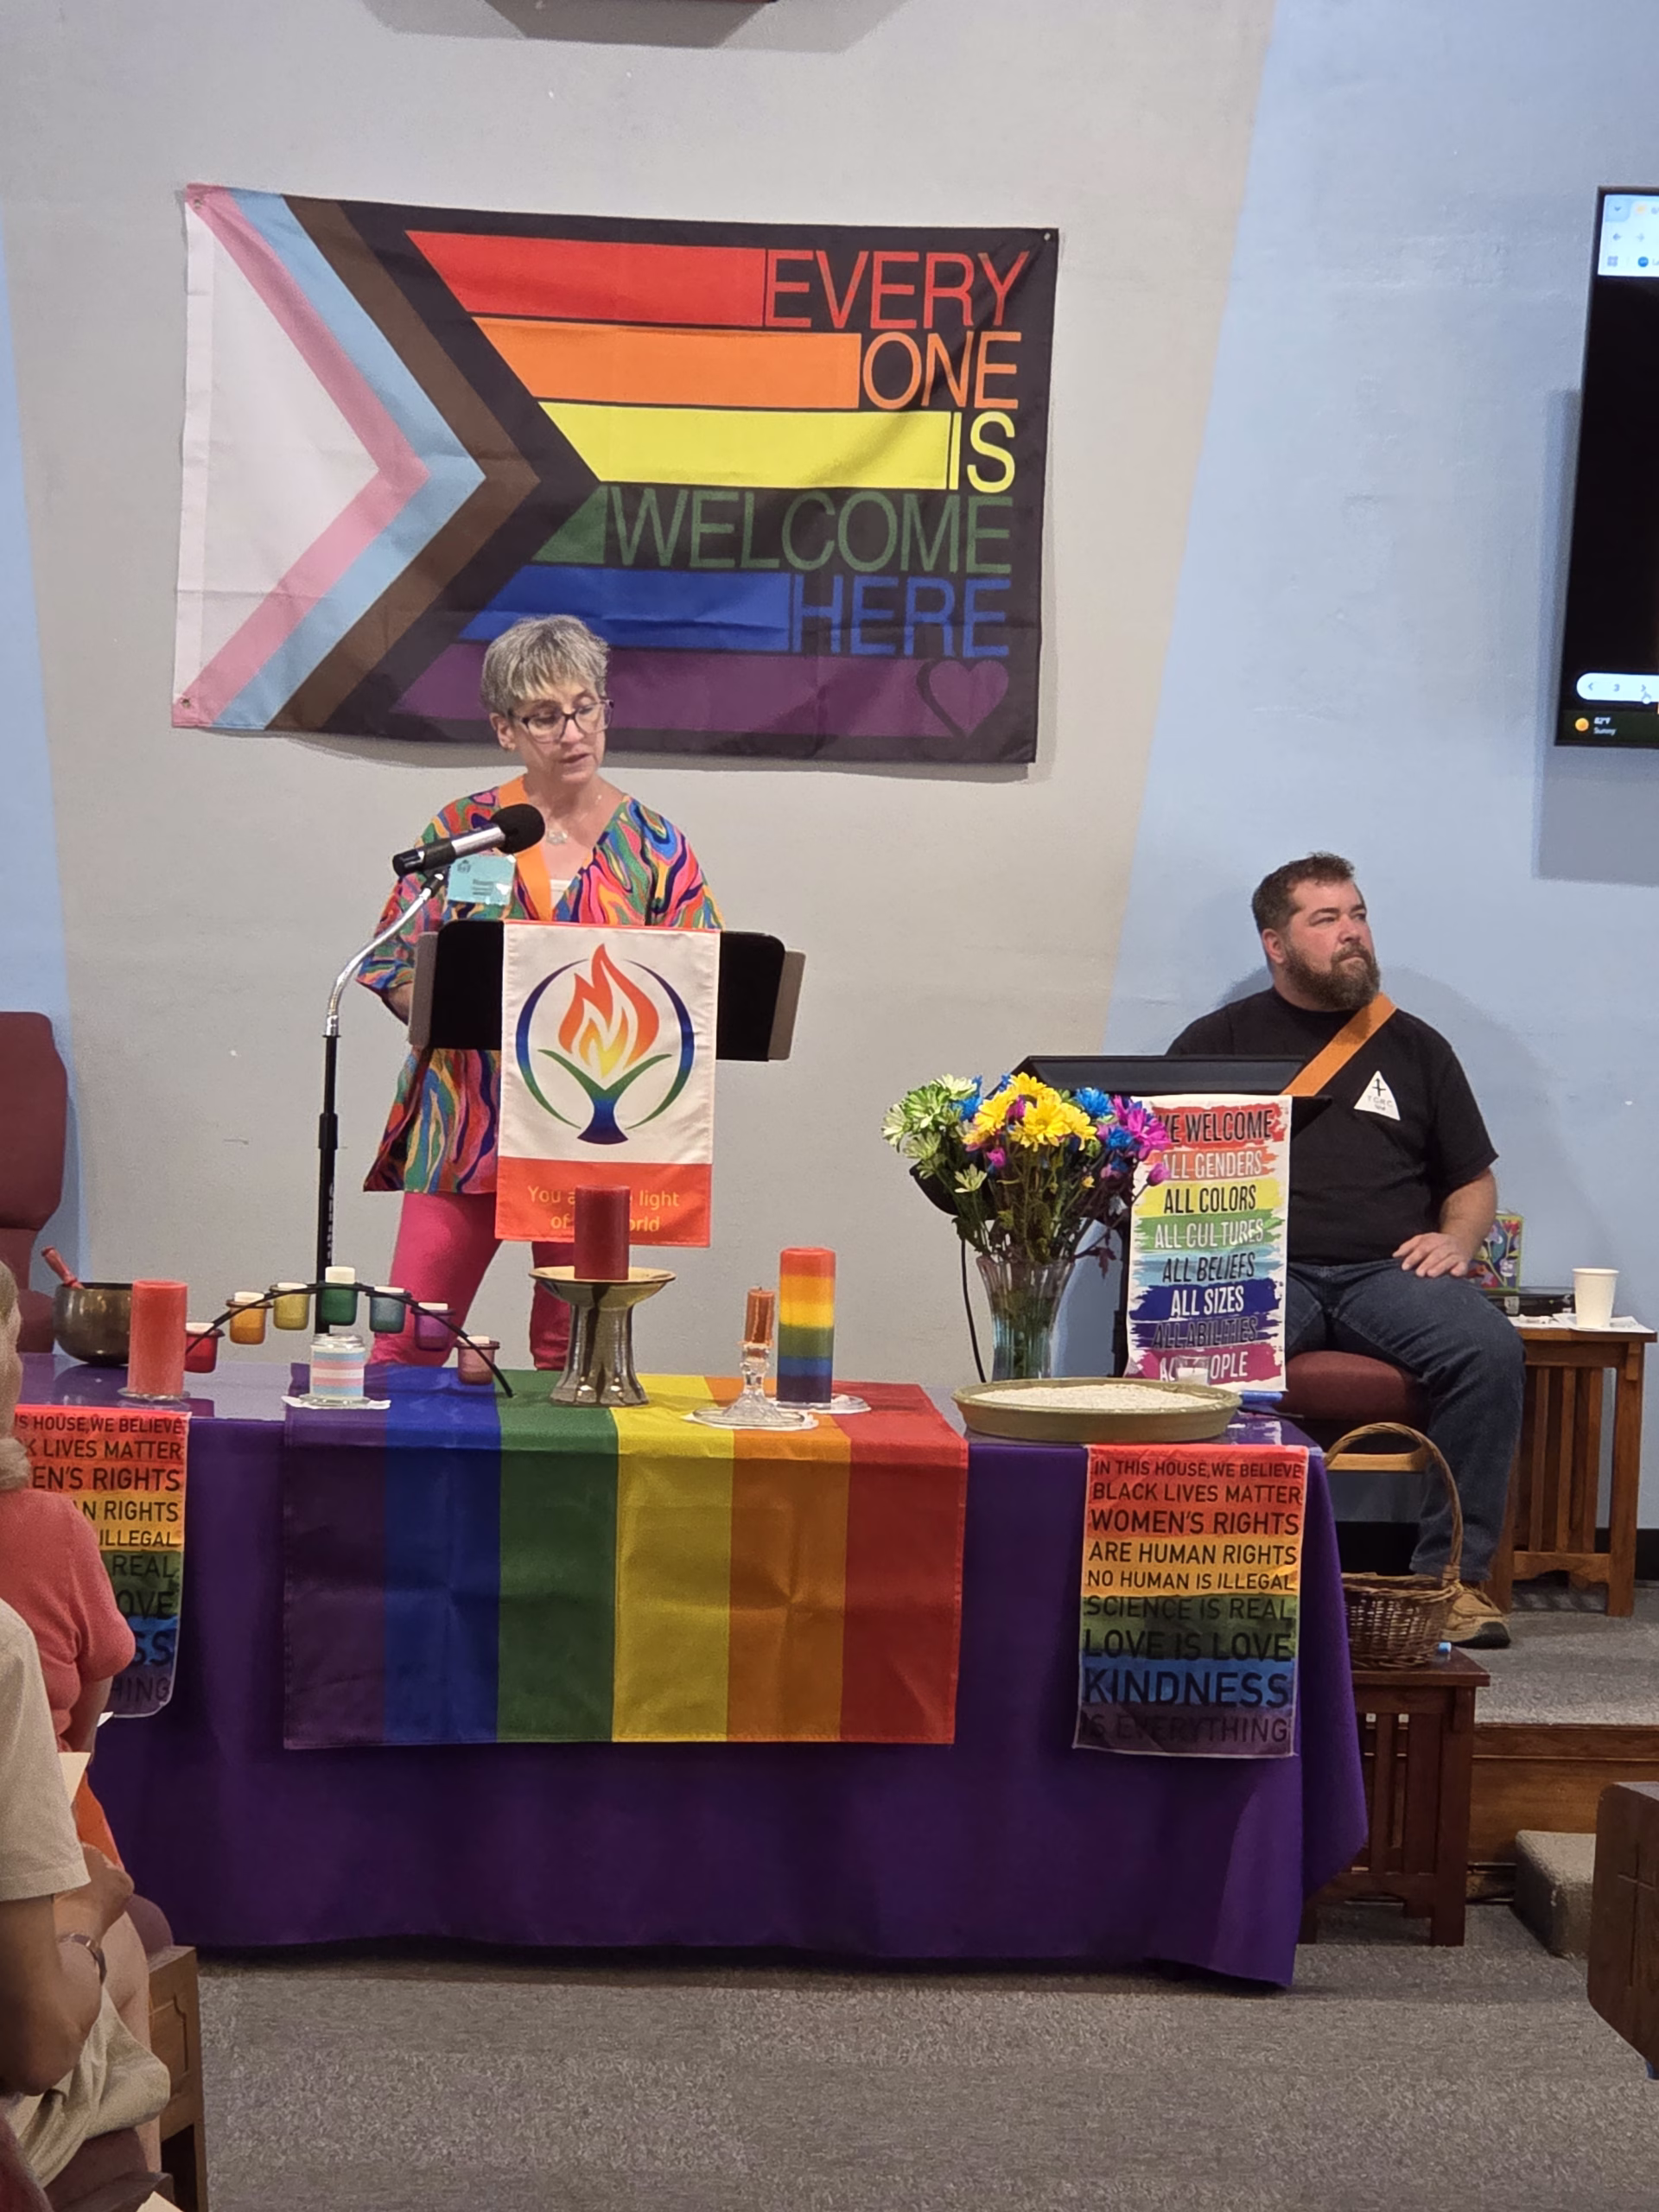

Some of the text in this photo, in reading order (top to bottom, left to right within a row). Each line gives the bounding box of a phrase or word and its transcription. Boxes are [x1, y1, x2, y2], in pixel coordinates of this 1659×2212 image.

[766, 251, 1029, 328] EVERY
[863, 331, 1021, 410] ONE
[949, 411, 1016, 493] IS
[612, 489, 1013, 573] WELCOME
[797, 576, 1010, 657] HERE
[1185, 1109, 1274, 1143] WELCOME
[1195, 1150, 1262, 1179] GENDERS
[527, 1185, 562, 1204] You
[639, 1190, 680, 1211] light
[1164, 1185, 1256, 1214] ALL COLORS
[550, 1213, 660, 1232] of orld
[1154, 1218, 1264, 1249] ALL CULTURES
[1162, 1252, 1255, 1283] ALL BELIEFS
[1171, 1285, 1244, 1318] ALL SIZES
[1152, 1317, 1258, 1350] ALL ABILITIES
[1210, 1351, 1249, 1380] OPLE
[119, 1417, 182, 1434] BELIEVE
[43, 1439, 97, 1459] LIVES
[105, 1440, 182, 1460] MATTER
[32, 1465, 181, 1492] EN'S RIGHTS
[1095, 1460, 1110, 1476] IN
[1116, 1460, 1151, 1477] THIS
[1240, 1462, 1302, 1479] BELIEVE
[1093, 1482, 1302, 1506] BLACK LIVES MATTER
[104, 1500, 179, 1522] RIGHTS
[1090, 1508, 1300, 1536] WOMEN'S RIGHTS
[99, 1529, 181, 1548] ILLEGAL
[112, 1554, 175, 1579] REAL
[1089, 1541, 1297, 1566] ARE HUMAN RIGHTS
[1087, 1569, 1297, 1591] NO HUMAN IS ILLEGAL
[116, 1589, 176, 1621] OVE
[1085, 1594, 1294, 1622] SCIENCE IS REAL
[1084, 1628, 1293, 1662] LOVE IS LOVE
[1084, 1667, 1290, 1709] KINDNESS
[1117, 1713, 1287, 1743] EVERYTHING
